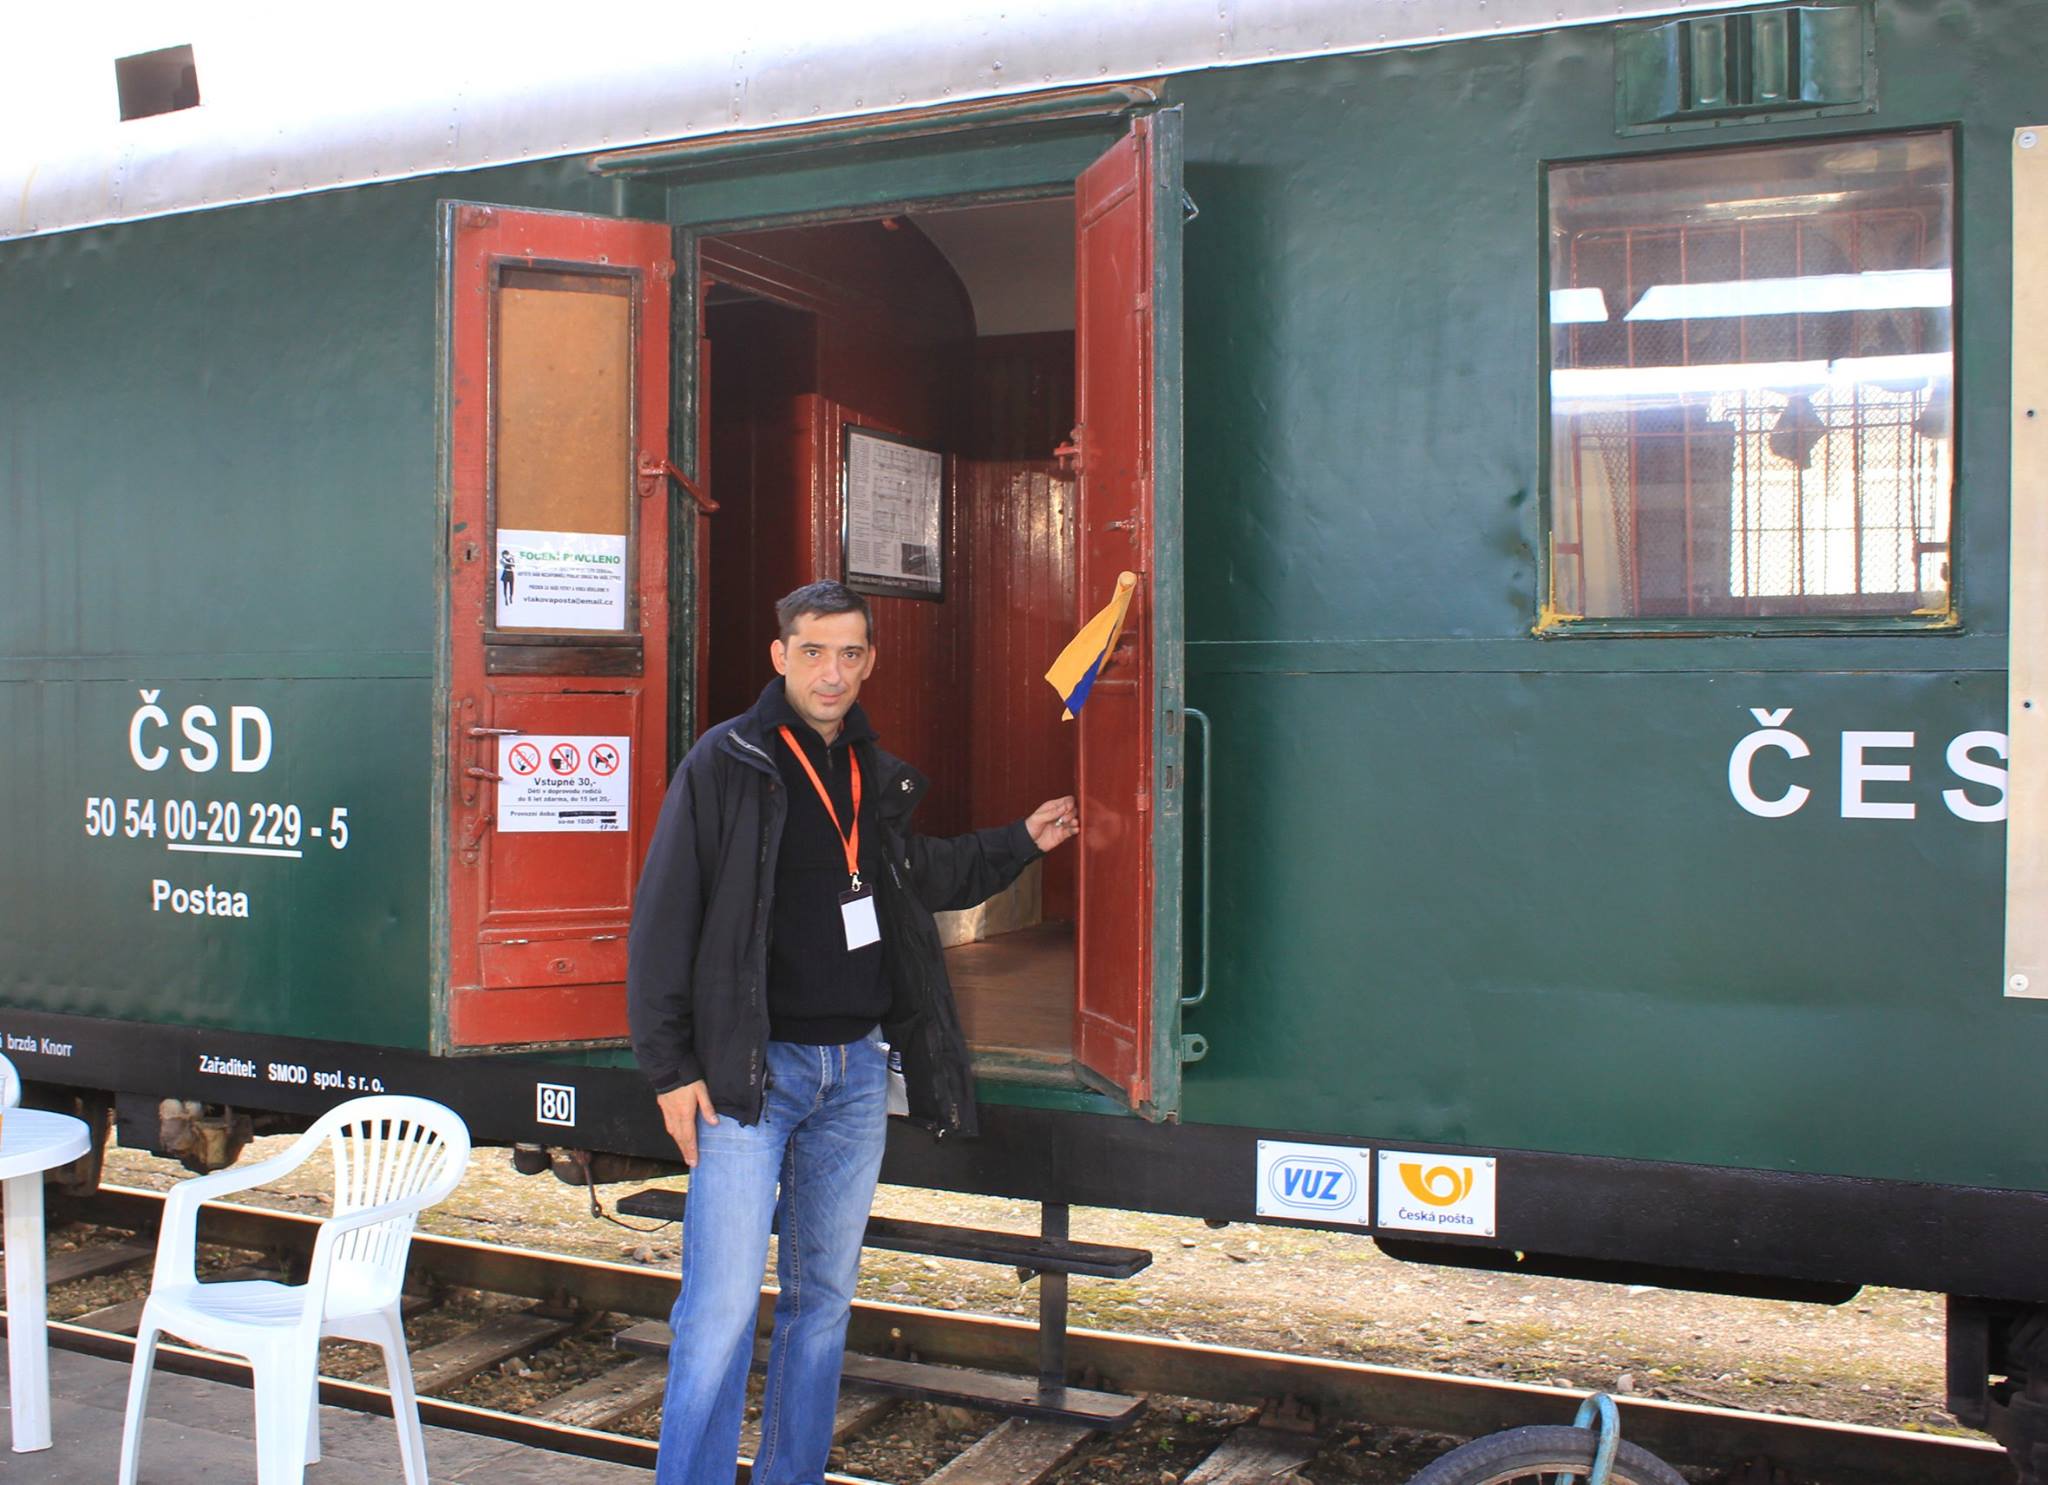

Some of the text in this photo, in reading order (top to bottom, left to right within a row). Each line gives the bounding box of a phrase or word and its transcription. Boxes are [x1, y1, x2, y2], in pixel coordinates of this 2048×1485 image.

[129, 689, 272, 773] ČSD
[534, 777, 597, 788] Vstupné 30,-
[85, 797, 116, 837] 50
[125, 798, 156, 838] 54
[164, 800, 240, 843] 00-20
[249, 803, 301, 847] 229
[330, 808, 348, 849] 5
[152, 879, 249, 918] Postaa
[7, 1033, 37, 1052] brzda
[41, 1037, 72, 1057] Knorr
[199, 1054, 257, 1079] Zařaditel:
[268, 1062, 307, 1084] SMOD
[313, 1070, 345, 1090] spol.
[348, 1075, 356, 1090] s
[543, 1089, 569, 1120] 80
[1284, 1167, 1343, 1200] VUZ
[1398, 1206, 1474, 1225] Česká pošta
